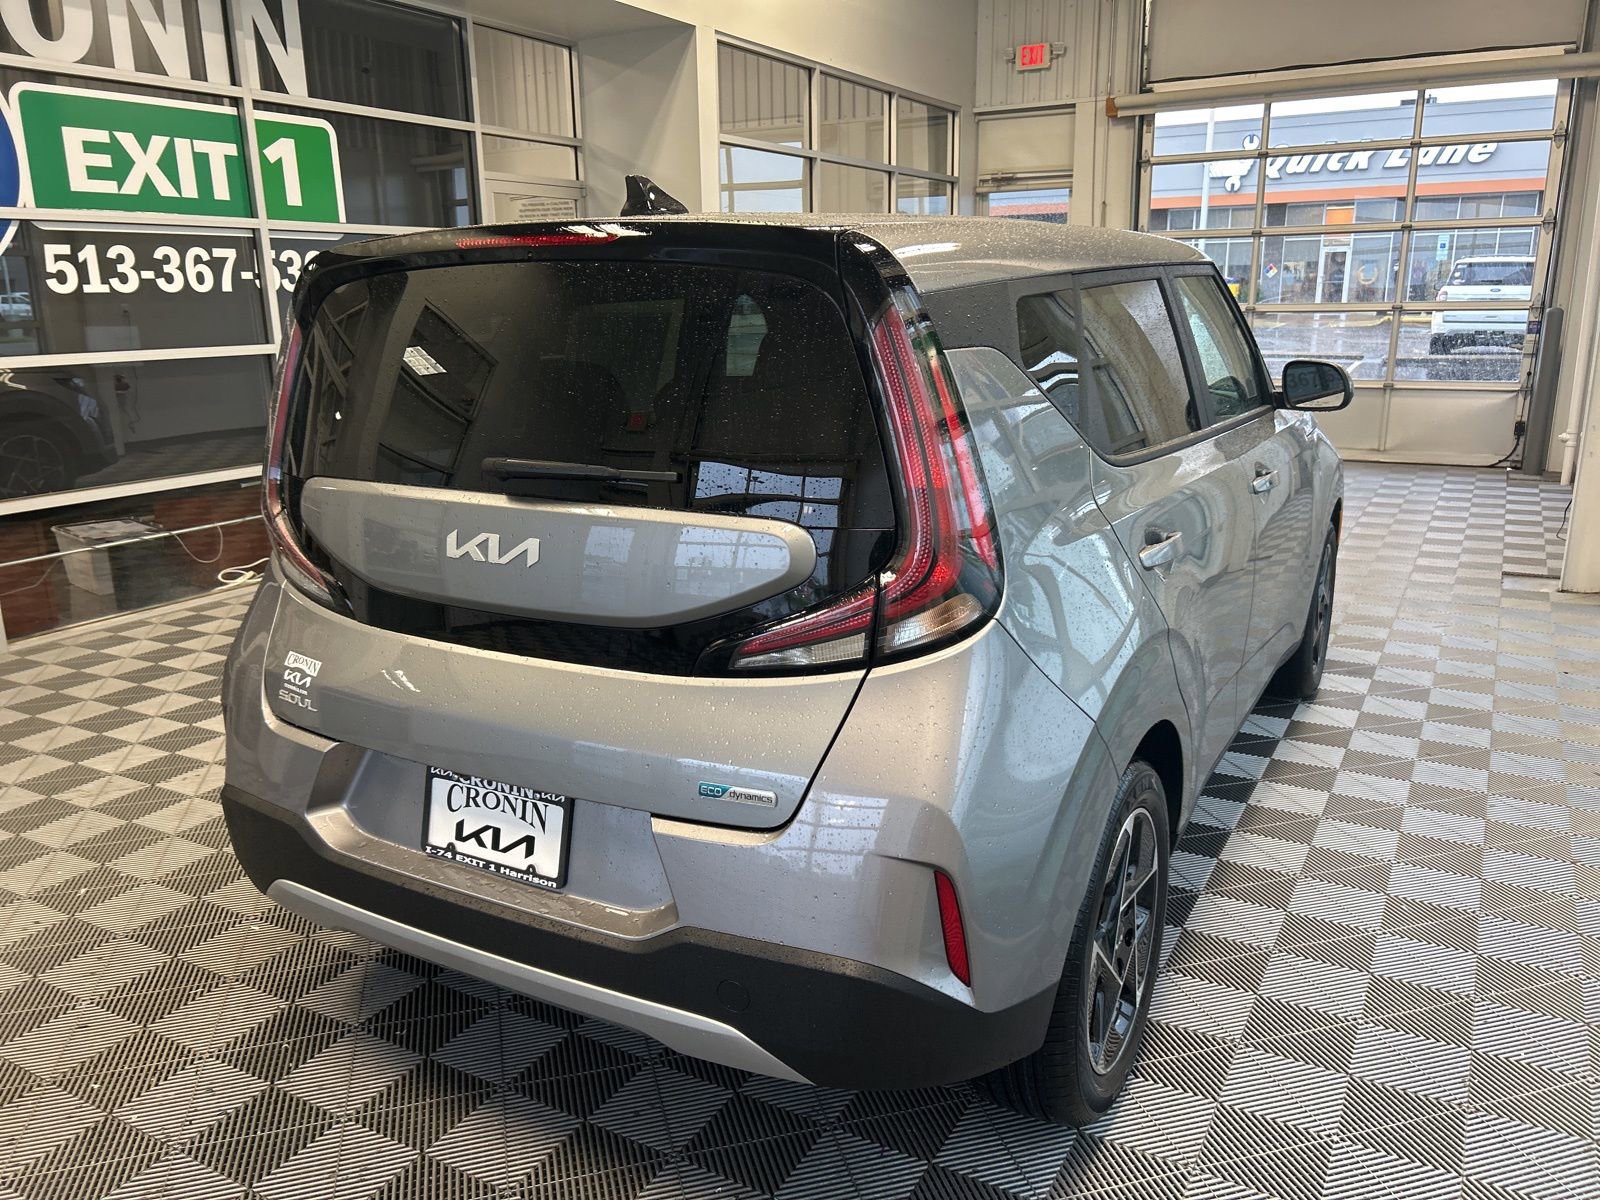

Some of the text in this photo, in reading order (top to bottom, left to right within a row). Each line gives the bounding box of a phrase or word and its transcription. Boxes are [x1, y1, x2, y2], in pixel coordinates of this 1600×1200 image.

[1021, 44, 1045, 66] EXIT
[61, 126, 303, 207] EXIT 1
[446, 528, 540, 568] KIA
[287, 653, 320, 674] CRONIN
[279, 689, 318, 711] SOUL
[447, 783, 549, 835] CRONIN
[700, 785, 773, 804] ECO dynamics
[455, 818, 536, 859] KIA
[425, 845, 557, 889] I-74 EXIT 1 Harrison
